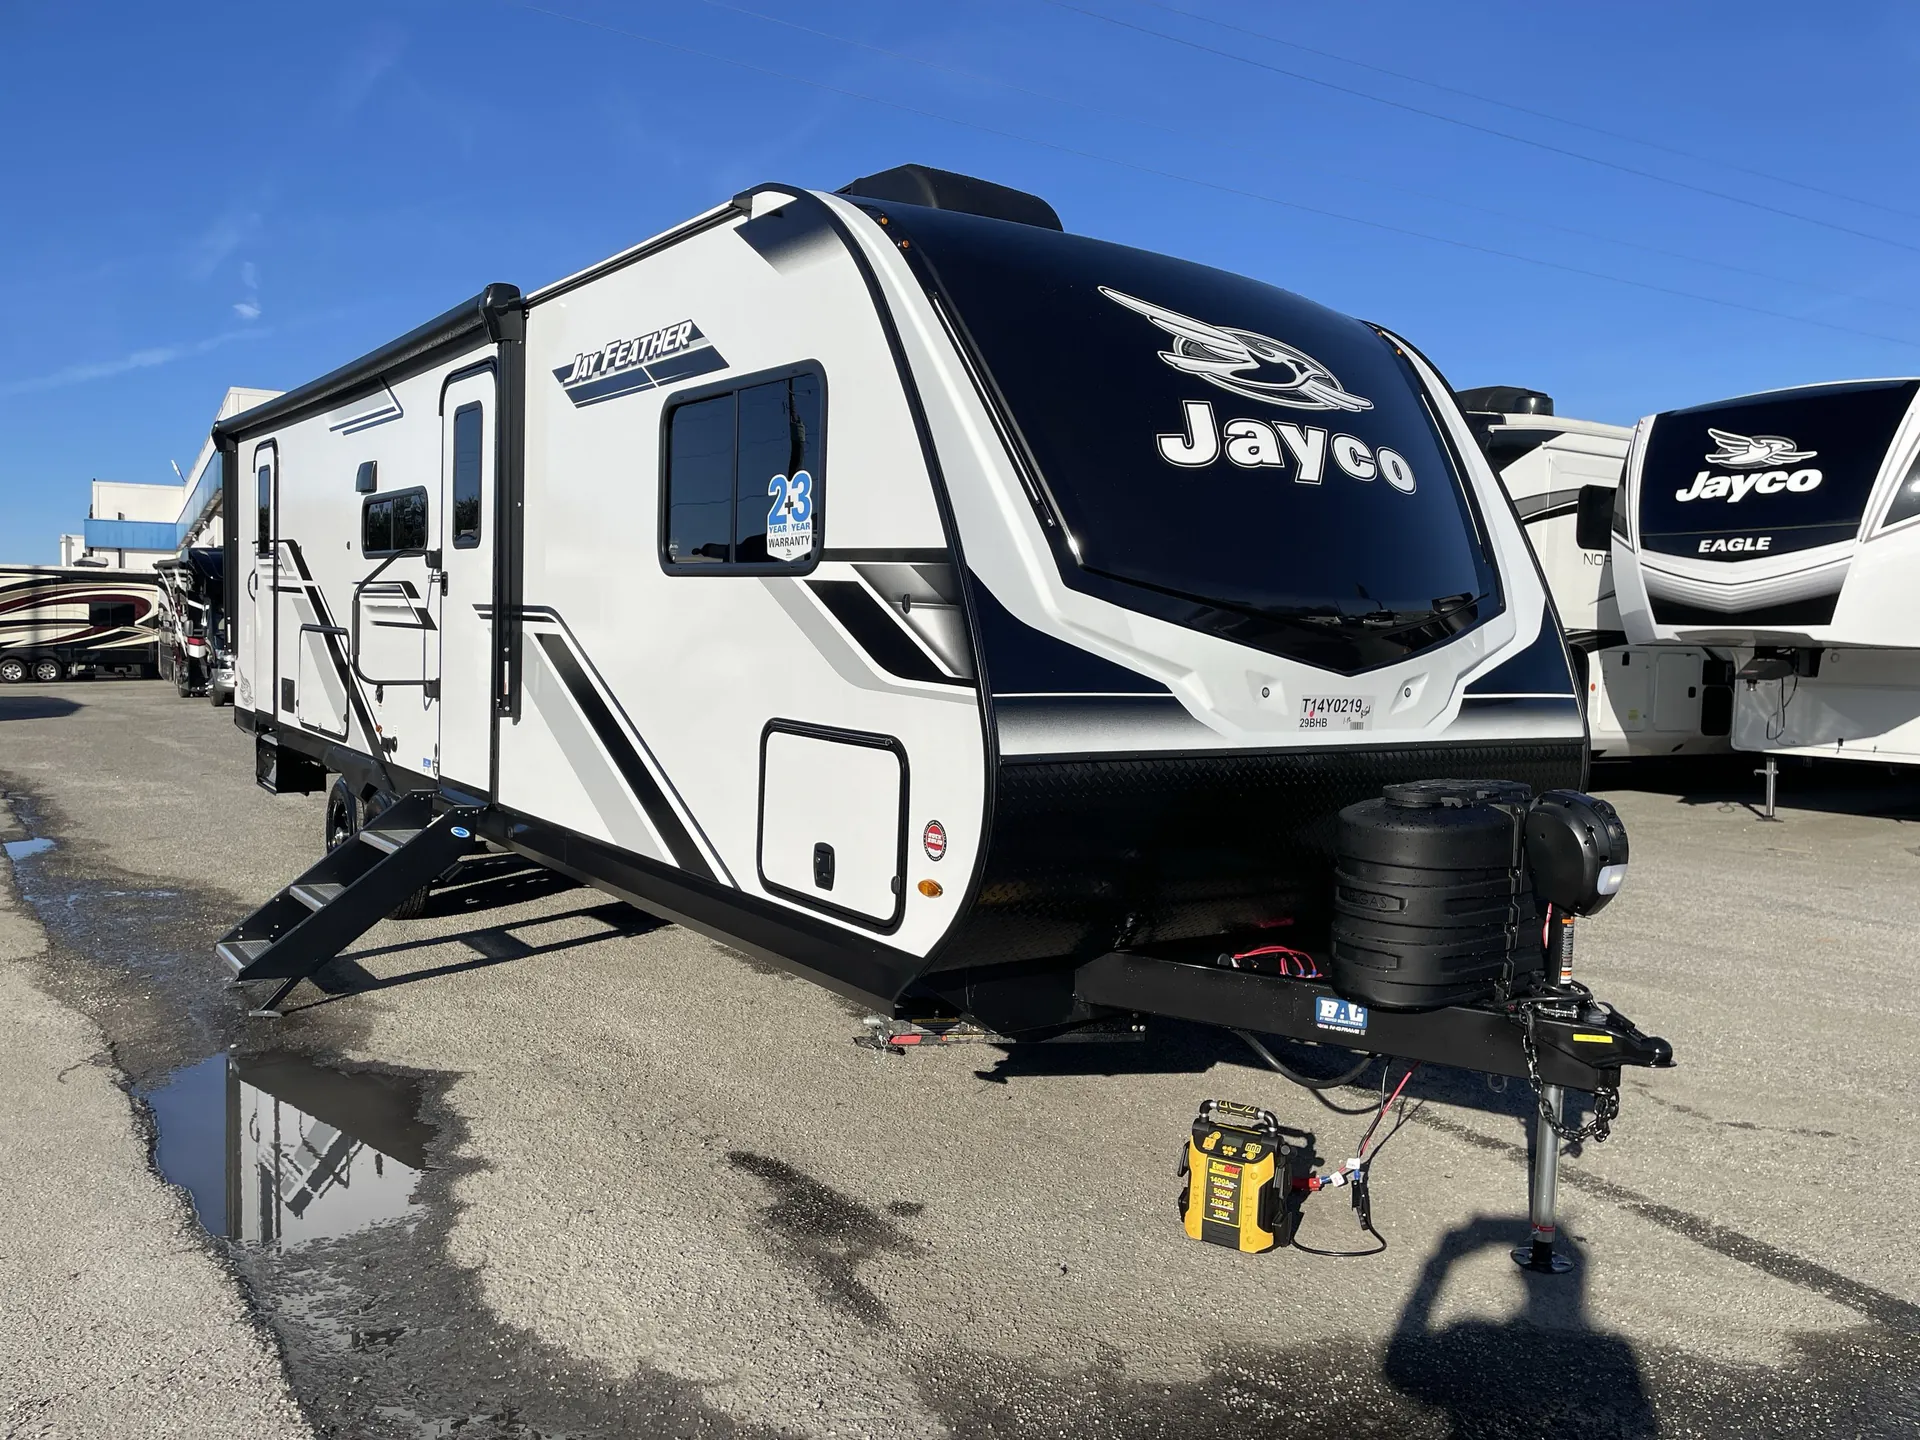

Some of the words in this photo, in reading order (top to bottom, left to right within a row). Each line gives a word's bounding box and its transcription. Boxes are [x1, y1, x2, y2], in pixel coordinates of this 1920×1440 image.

[563, 352, 601, 384] JAY
[600, 320, 693, 373] FEATHER
[1157, 400, 1416, 494] Jayco
[1675, 469, 1823, 503] Jayco
[769, 525, 787, 534] YEAR
[791, 522, 811, 532] YEAR
[768, 535, 811, 548] WARRANTY
[1698, 537, 1772, 553] EAGLE
[1302, 698, 1363, 713] T14Y0219
[1299, 717, 1328, 728] 29BHB
[1213, 1188, 1233, 1197] 500W
[1210, 1198, 1223, 1206] 120
